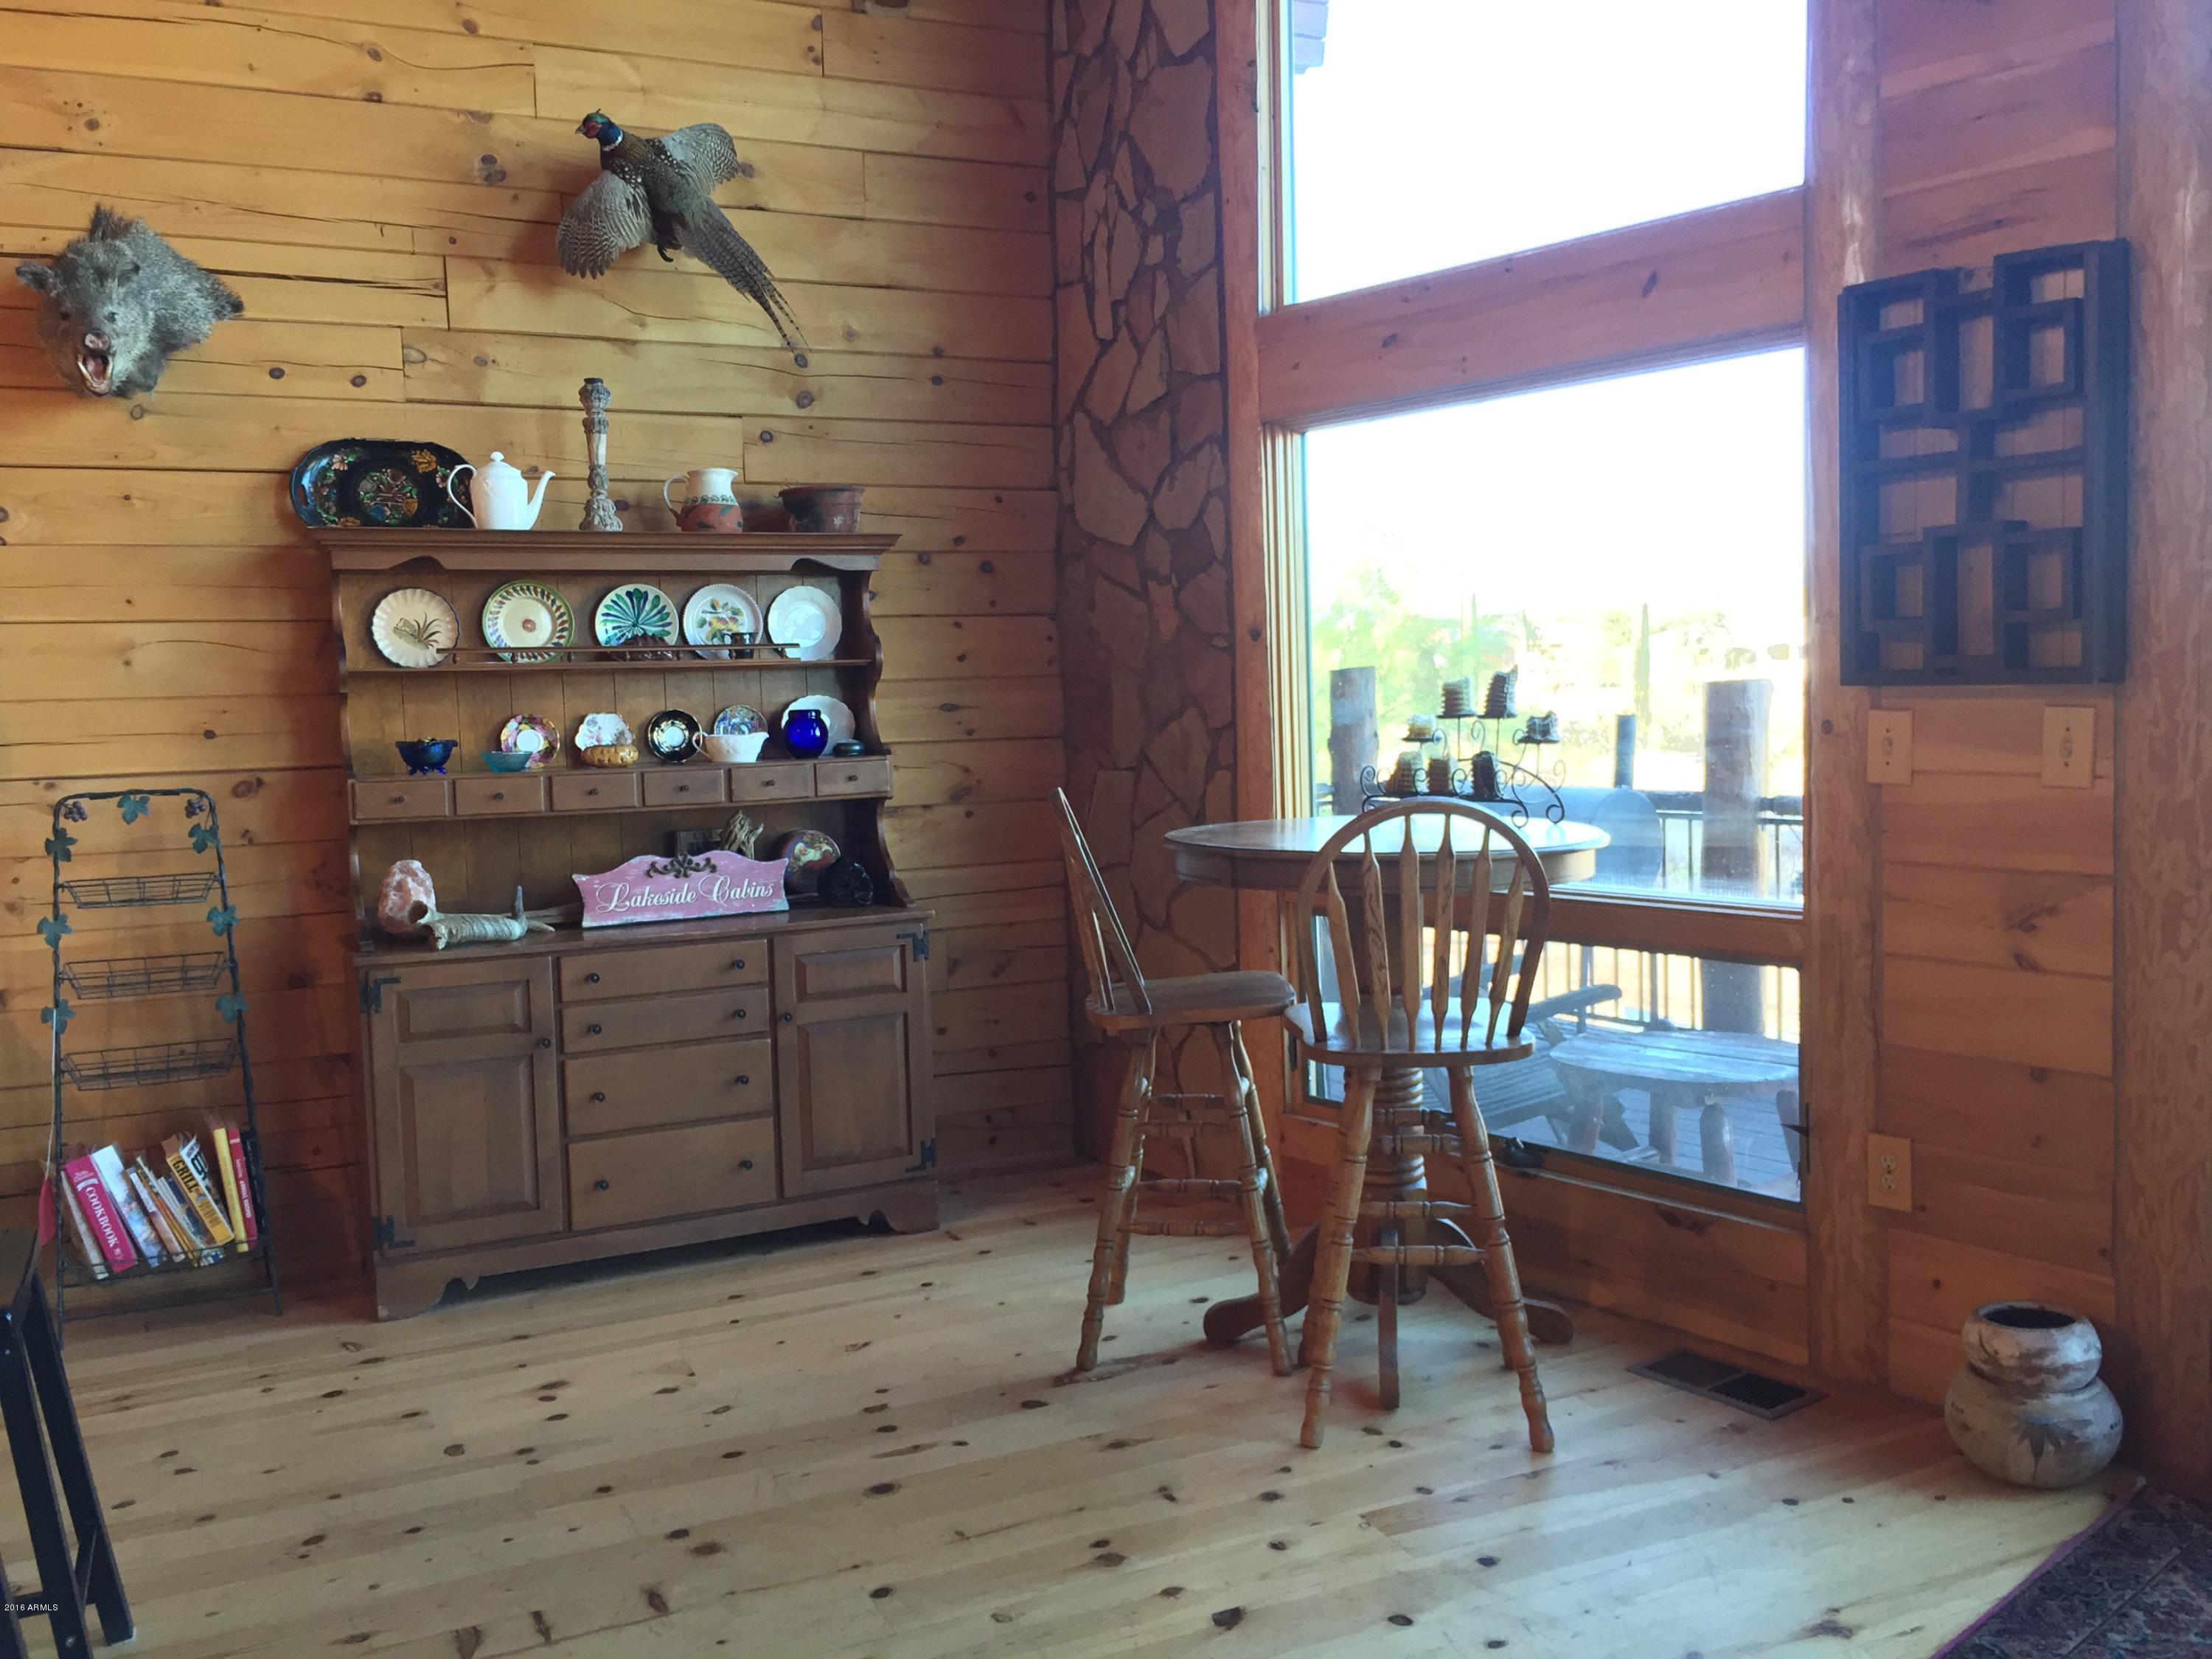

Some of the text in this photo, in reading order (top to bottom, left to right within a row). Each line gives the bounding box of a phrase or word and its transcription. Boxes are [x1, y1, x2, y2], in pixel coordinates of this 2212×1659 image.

[596, 874, 773, 913] Lakeside Cabins
[172, 1159, 200, 1194] GRILL
[85, 1186, 119, 1249] COOKBOOK
